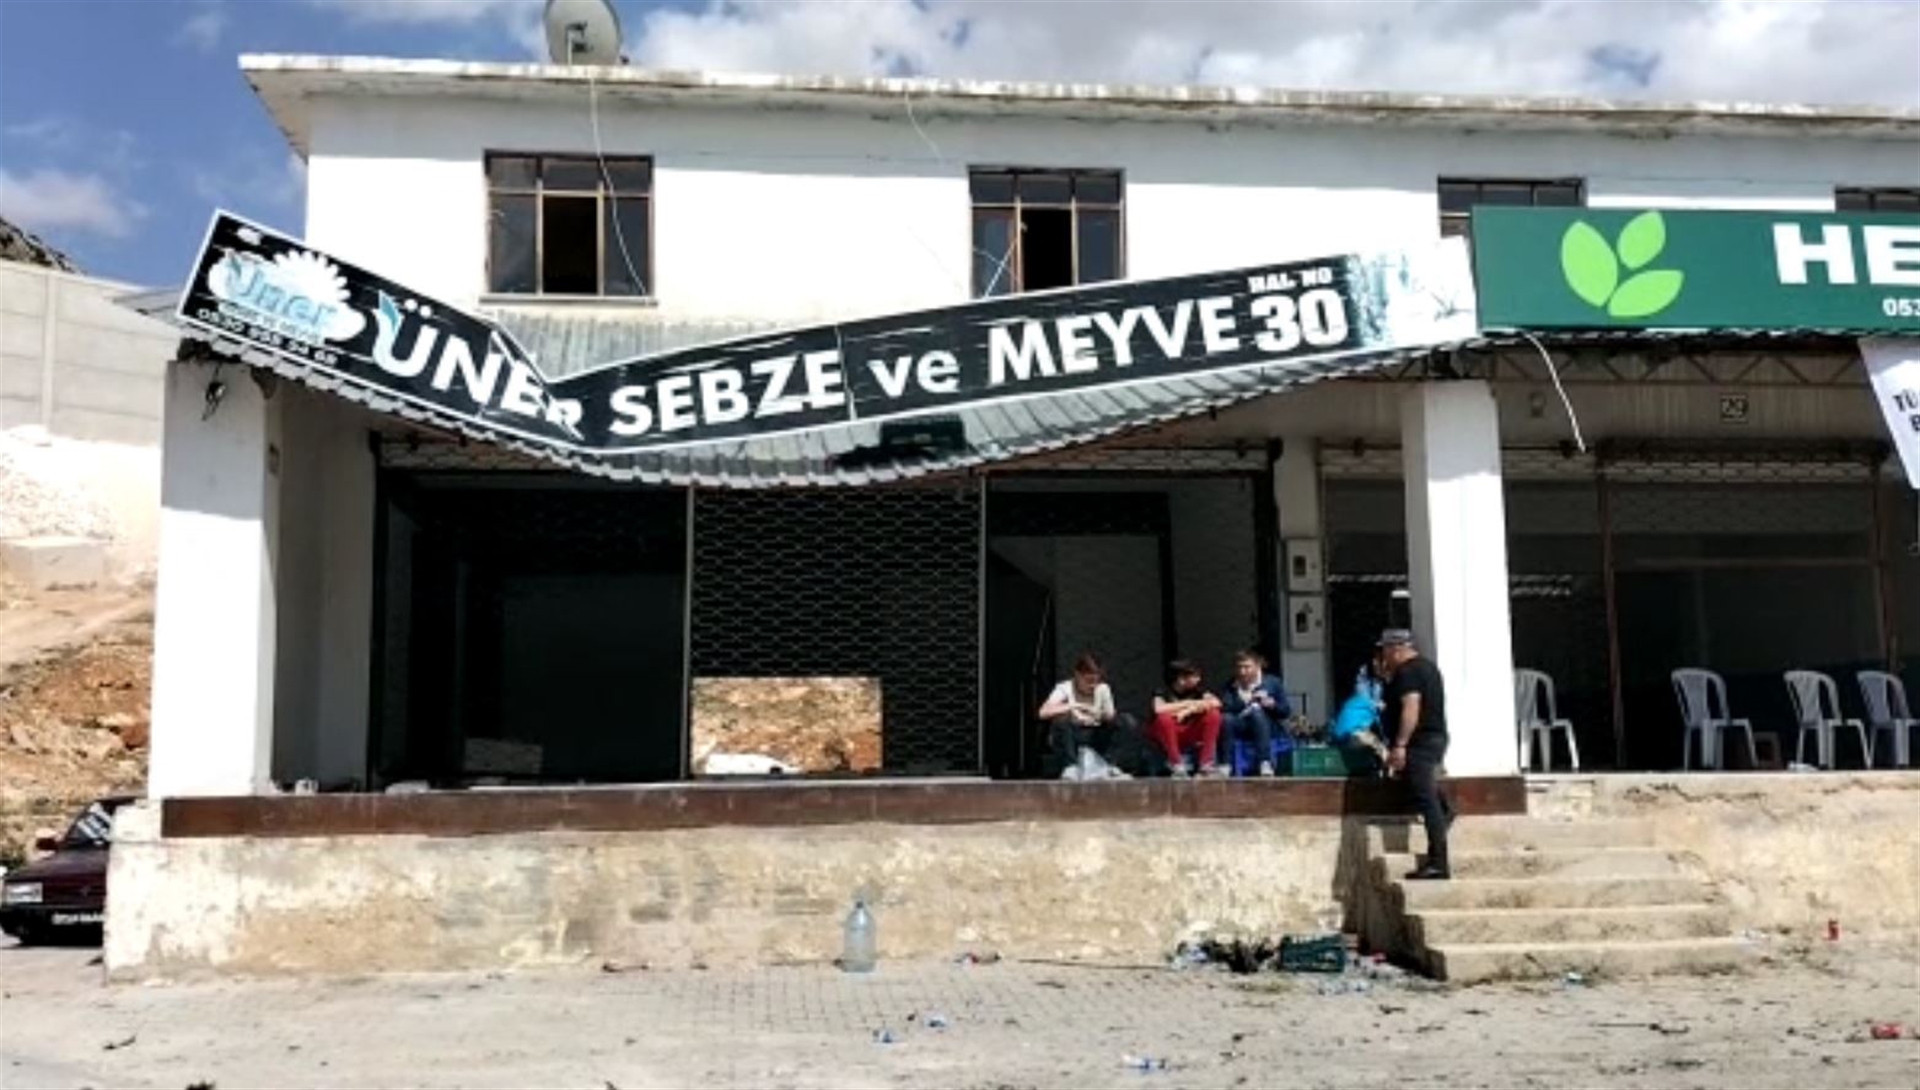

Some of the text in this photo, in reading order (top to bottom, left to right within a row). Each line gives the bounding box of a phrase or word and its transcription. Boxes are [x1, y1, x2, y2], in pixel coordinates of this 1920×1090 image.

[609, 350, 846, 436] SEBZE
[868, 350, 960, 398] ve
[987, 296, 1240, 386] MEYVE
[1250, 288, 1348, 352] 30
